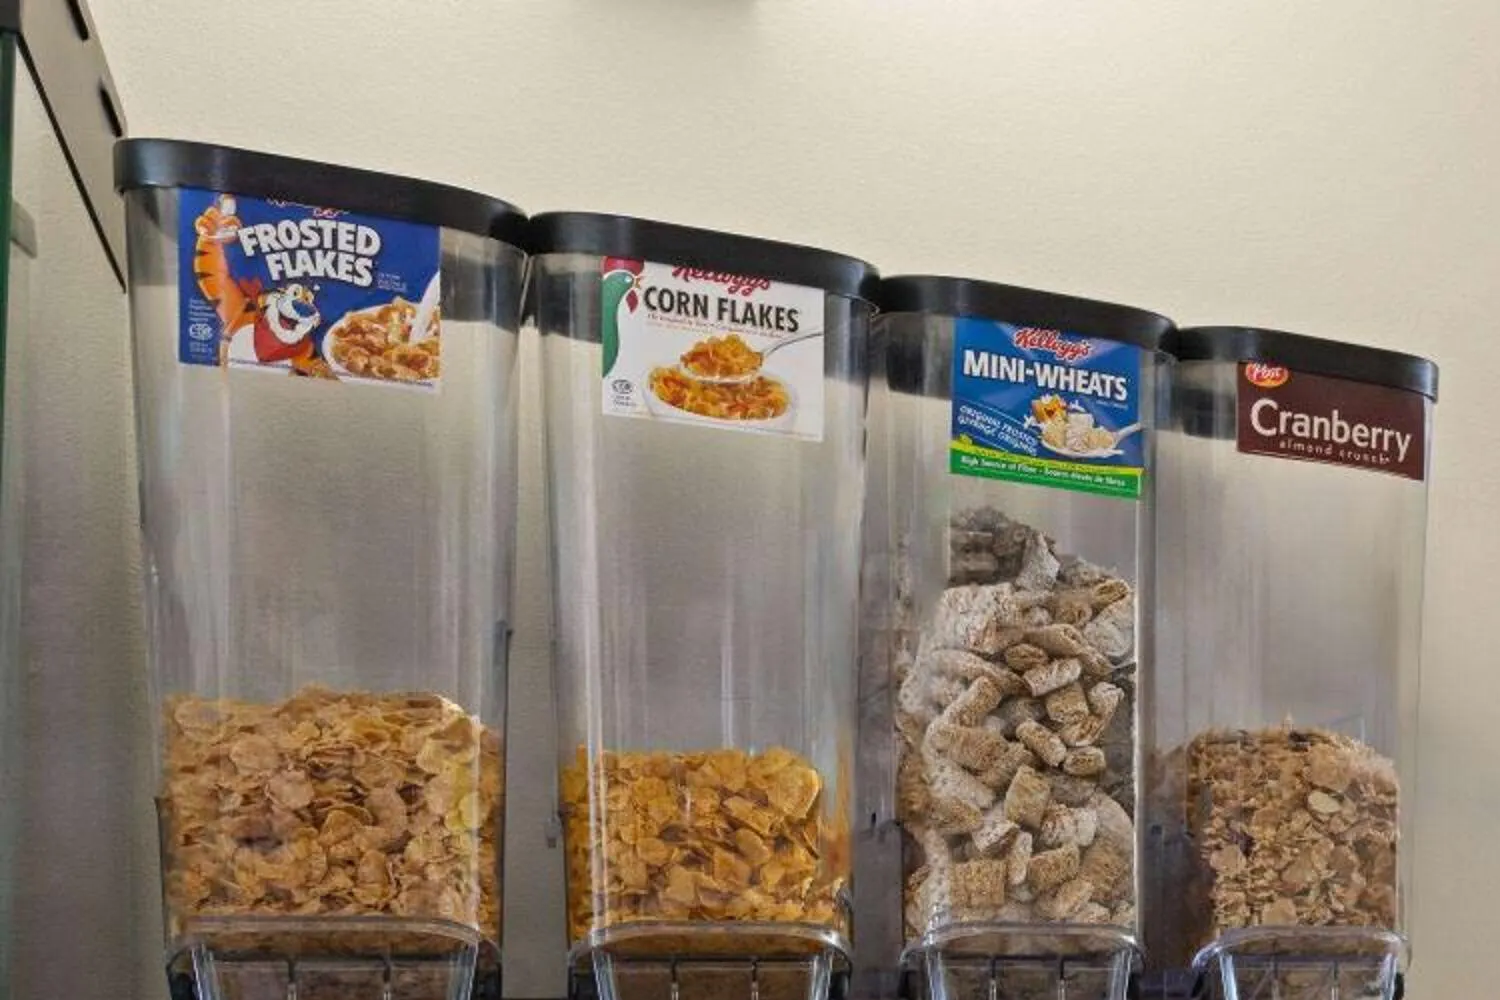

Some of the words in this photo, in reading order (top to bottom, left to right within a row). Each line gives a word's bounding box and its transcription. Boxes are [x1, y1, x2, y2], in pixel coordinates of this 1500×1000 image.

[237, 219, 381, 257] FROSTED
[266, 250, 374, 287] FLAKES
[643, 286, 708, 319] CORN
[717, 297, 799, 332] FLAKES
[1013, 327, 1091, 360] Kellogg's
[963, 350, 1128, 401] MINI-WHEATS
[1251, 398, 1412, 463] Cranberry
[1279, 440, 1333, 456] almond
[1339, 449, 1390, 465] crunch
